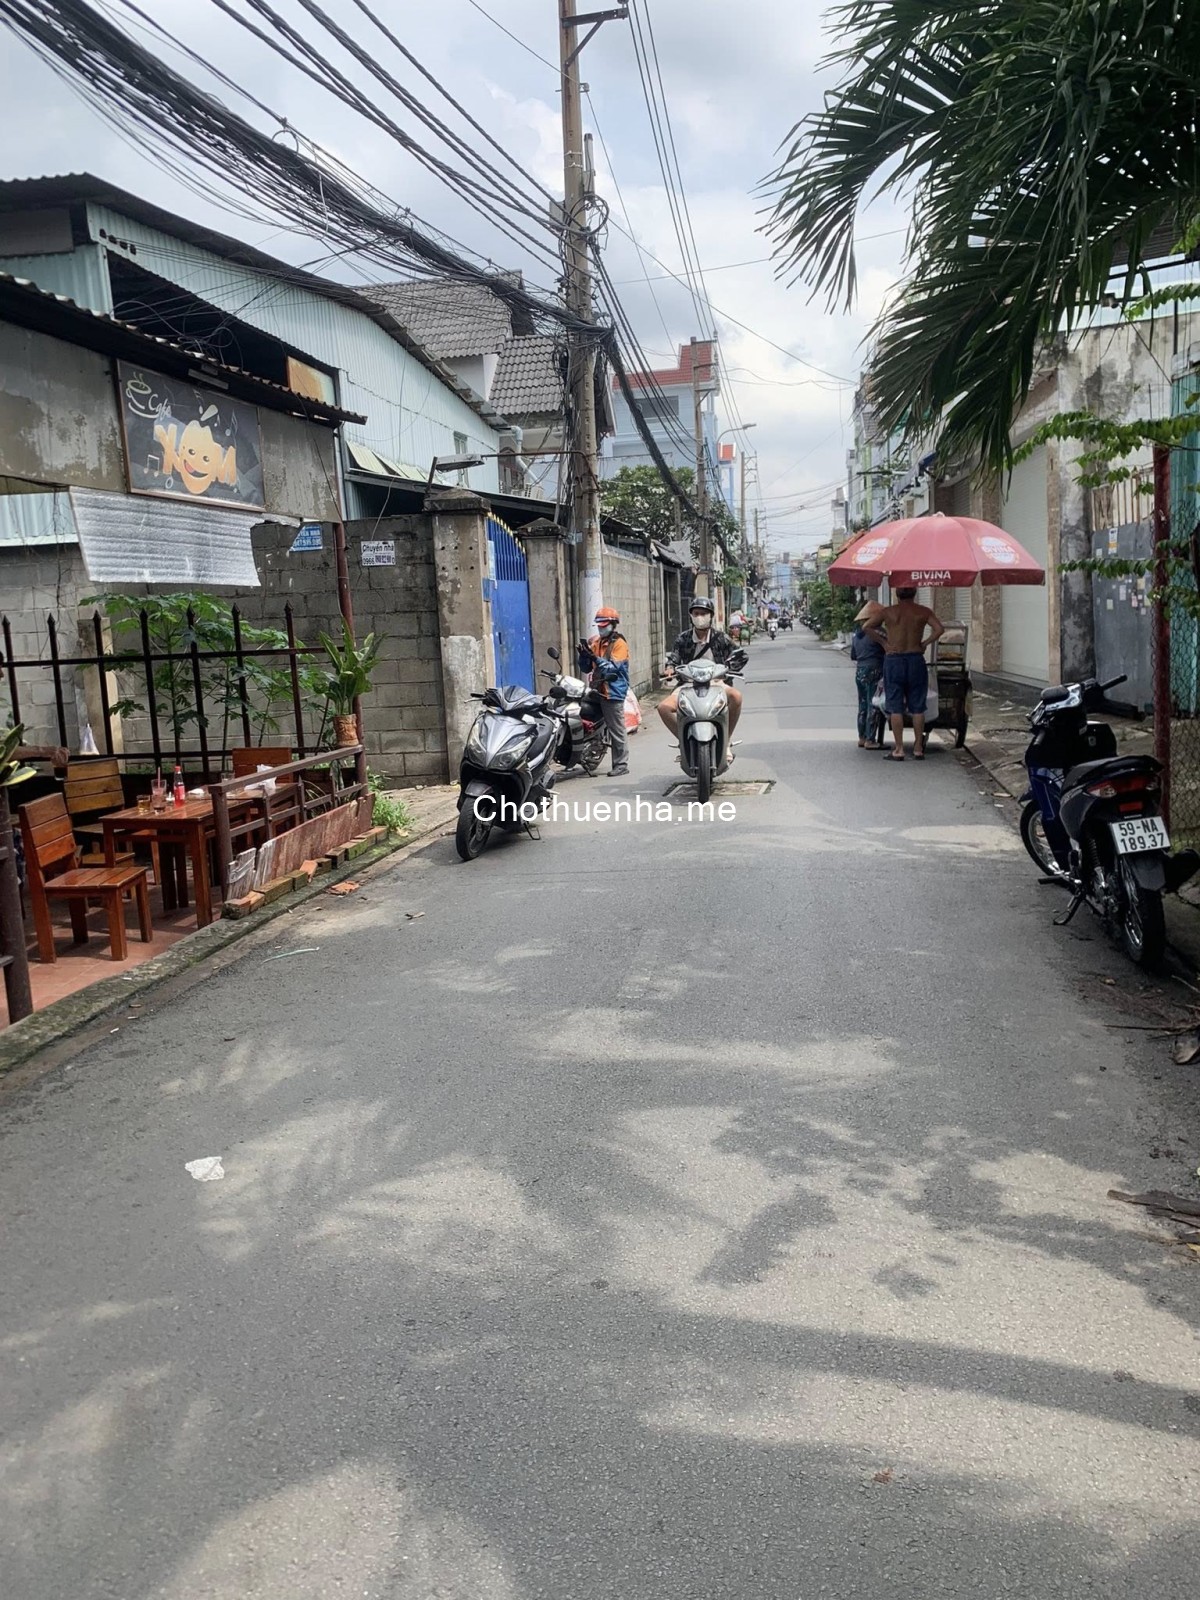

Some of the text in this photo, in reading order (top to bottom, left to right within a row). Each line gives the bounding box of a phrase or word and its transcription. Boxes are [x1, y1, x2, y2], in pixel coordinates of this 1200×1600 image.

[911, 570, 951, 580] BIVINA
[1118, 818, 1159, 837] 59-NA
[1120, 832, 1164, 852] 189.37
